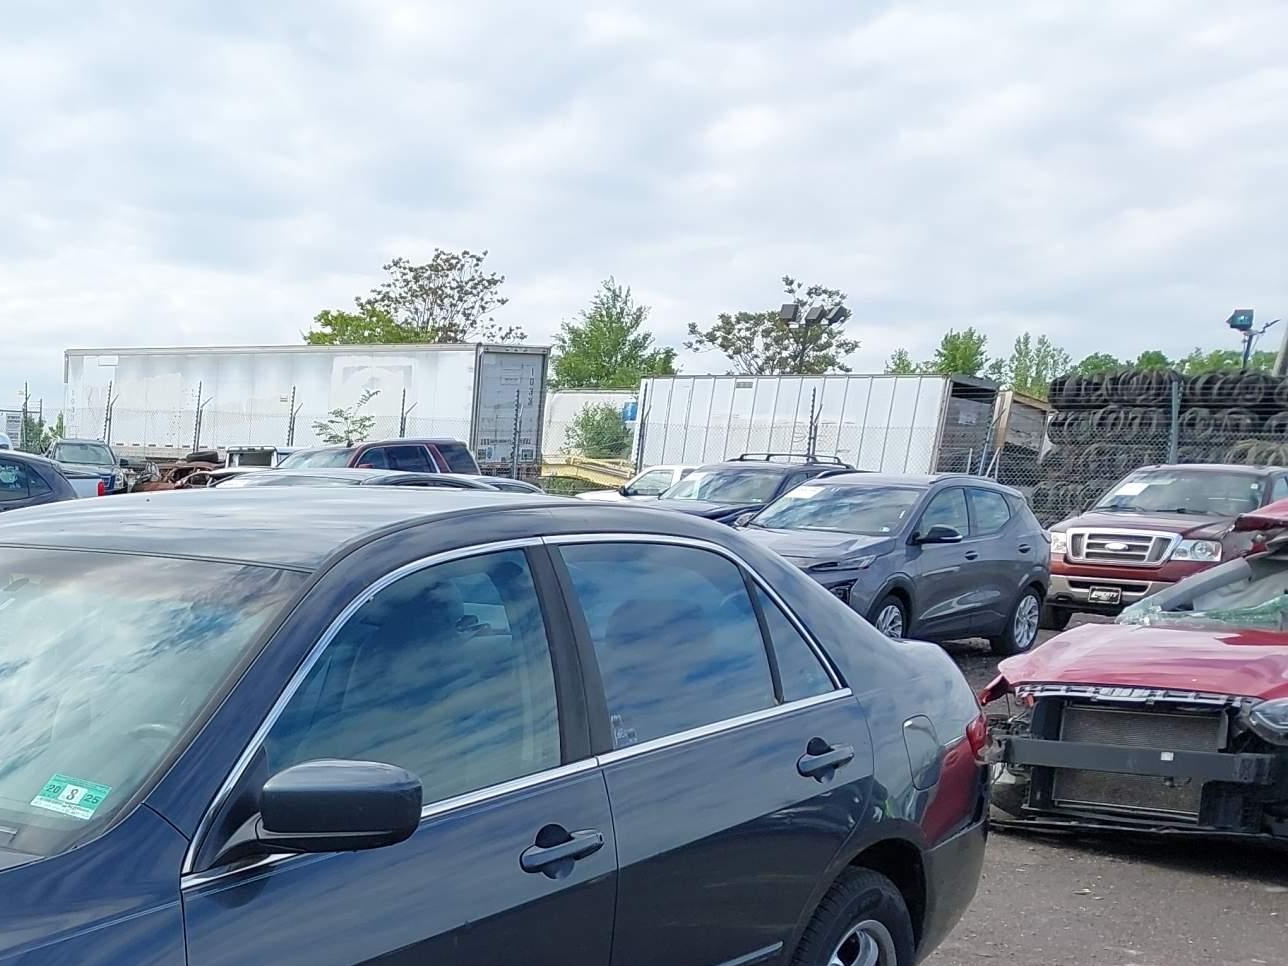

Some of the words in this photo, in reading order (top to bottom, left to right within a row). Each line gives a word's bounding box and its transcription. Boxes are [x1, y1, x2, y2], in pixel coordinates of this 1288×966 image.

[46, 784, 62, 794] 20
[66, 789, 79, 801] 8
[84, 794, 100, 804] 25
